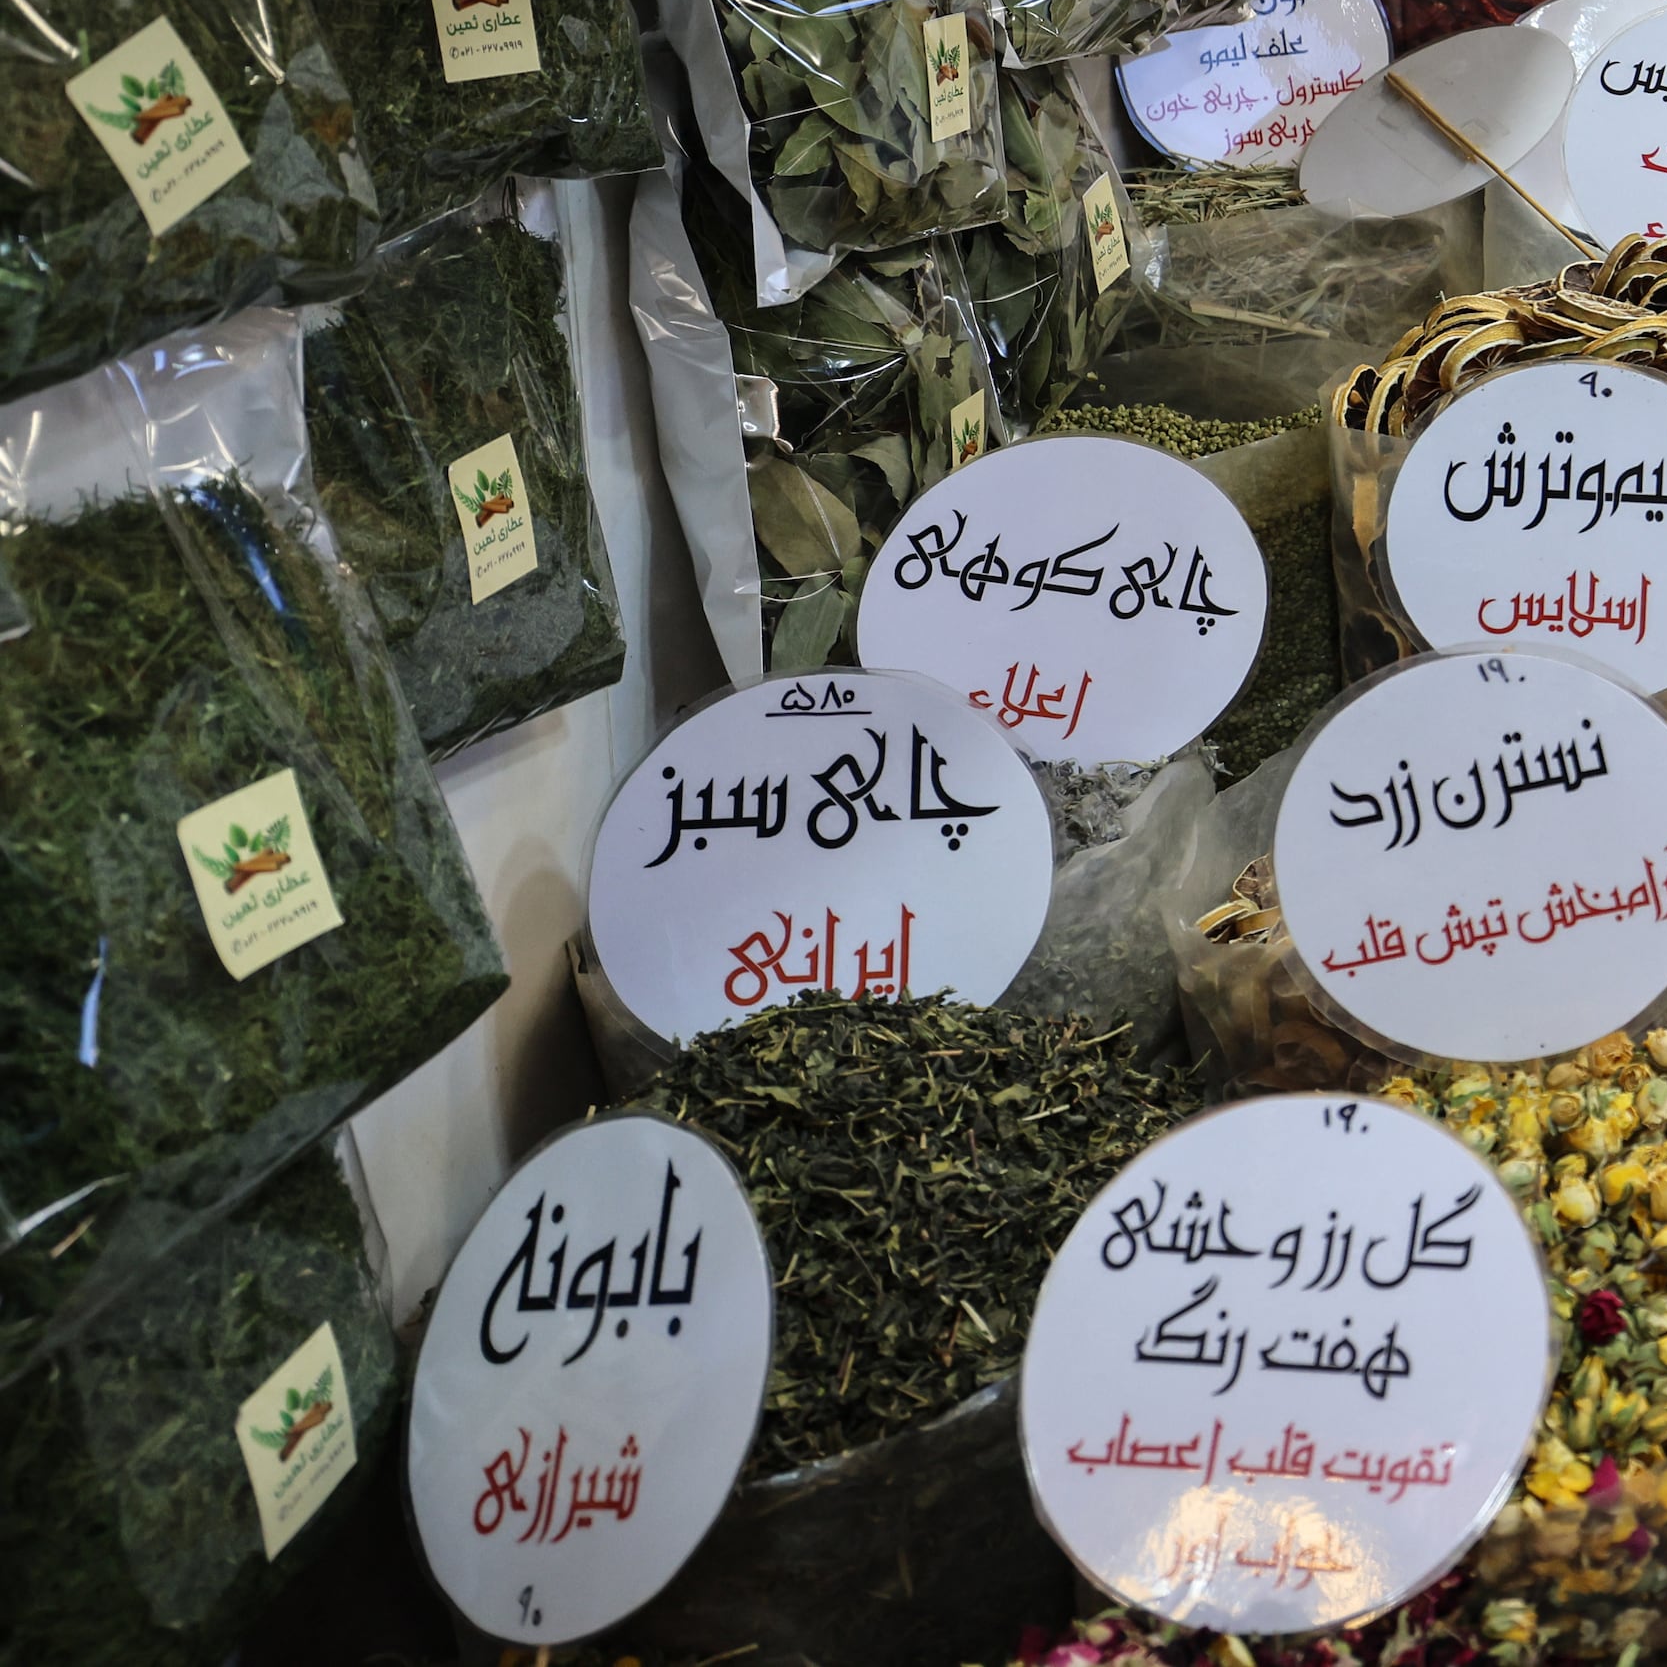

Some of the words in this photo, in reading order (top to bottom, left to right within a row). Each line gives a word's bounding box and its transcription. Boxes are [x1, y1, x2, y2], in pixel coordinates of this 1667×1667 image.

[446, 15, 478, 36] ثمین
[482, 12, 521, 32] عطاری
[1200, 32, 1246, 74] لیمو
[1252, 29, 1308, 59] علف
[175, 111, 214, 152] عطاری
[1146, 93, 1197, 121] خون
[474, 528, 495, 555] ثمین
[498, 516, 523, 542] عطاری
[894, 509, 1120, 612] کوهی
[1109, 542, 1240, 636] چای
[1478, 570, 1651, 645] اسلایس
[806, 724, 1001, 852] چای
[1329, 760, 1422, 852] زرد
[1432, 718, 1609, 830] نسترن
[643, 765, 789, 869] سبز
[724, 902, 916, 1007] ایرانی
[1321, 915, 1407, 978] قلب
[1415, 899, 1509, 966] تپش
[480, 1157, 703, 1367] بابونه
[1099, 1177, 1303, 1289] وحشی
[1301, 1209, 1353, 1292] رز
[1362, 1182, 1486, 1289] گل
[1134, 1275, 1250, 1397] رنگ
[1259, 1317, 1411, 1400] هفت
[473, 1425, 644, 1545] شیرازی
[1066, 1412, 1224, 1486] اعصاب
[1227, 1422, 1315, 1484] قلب
[1322, 1440, 1455, 1503] تقویت
